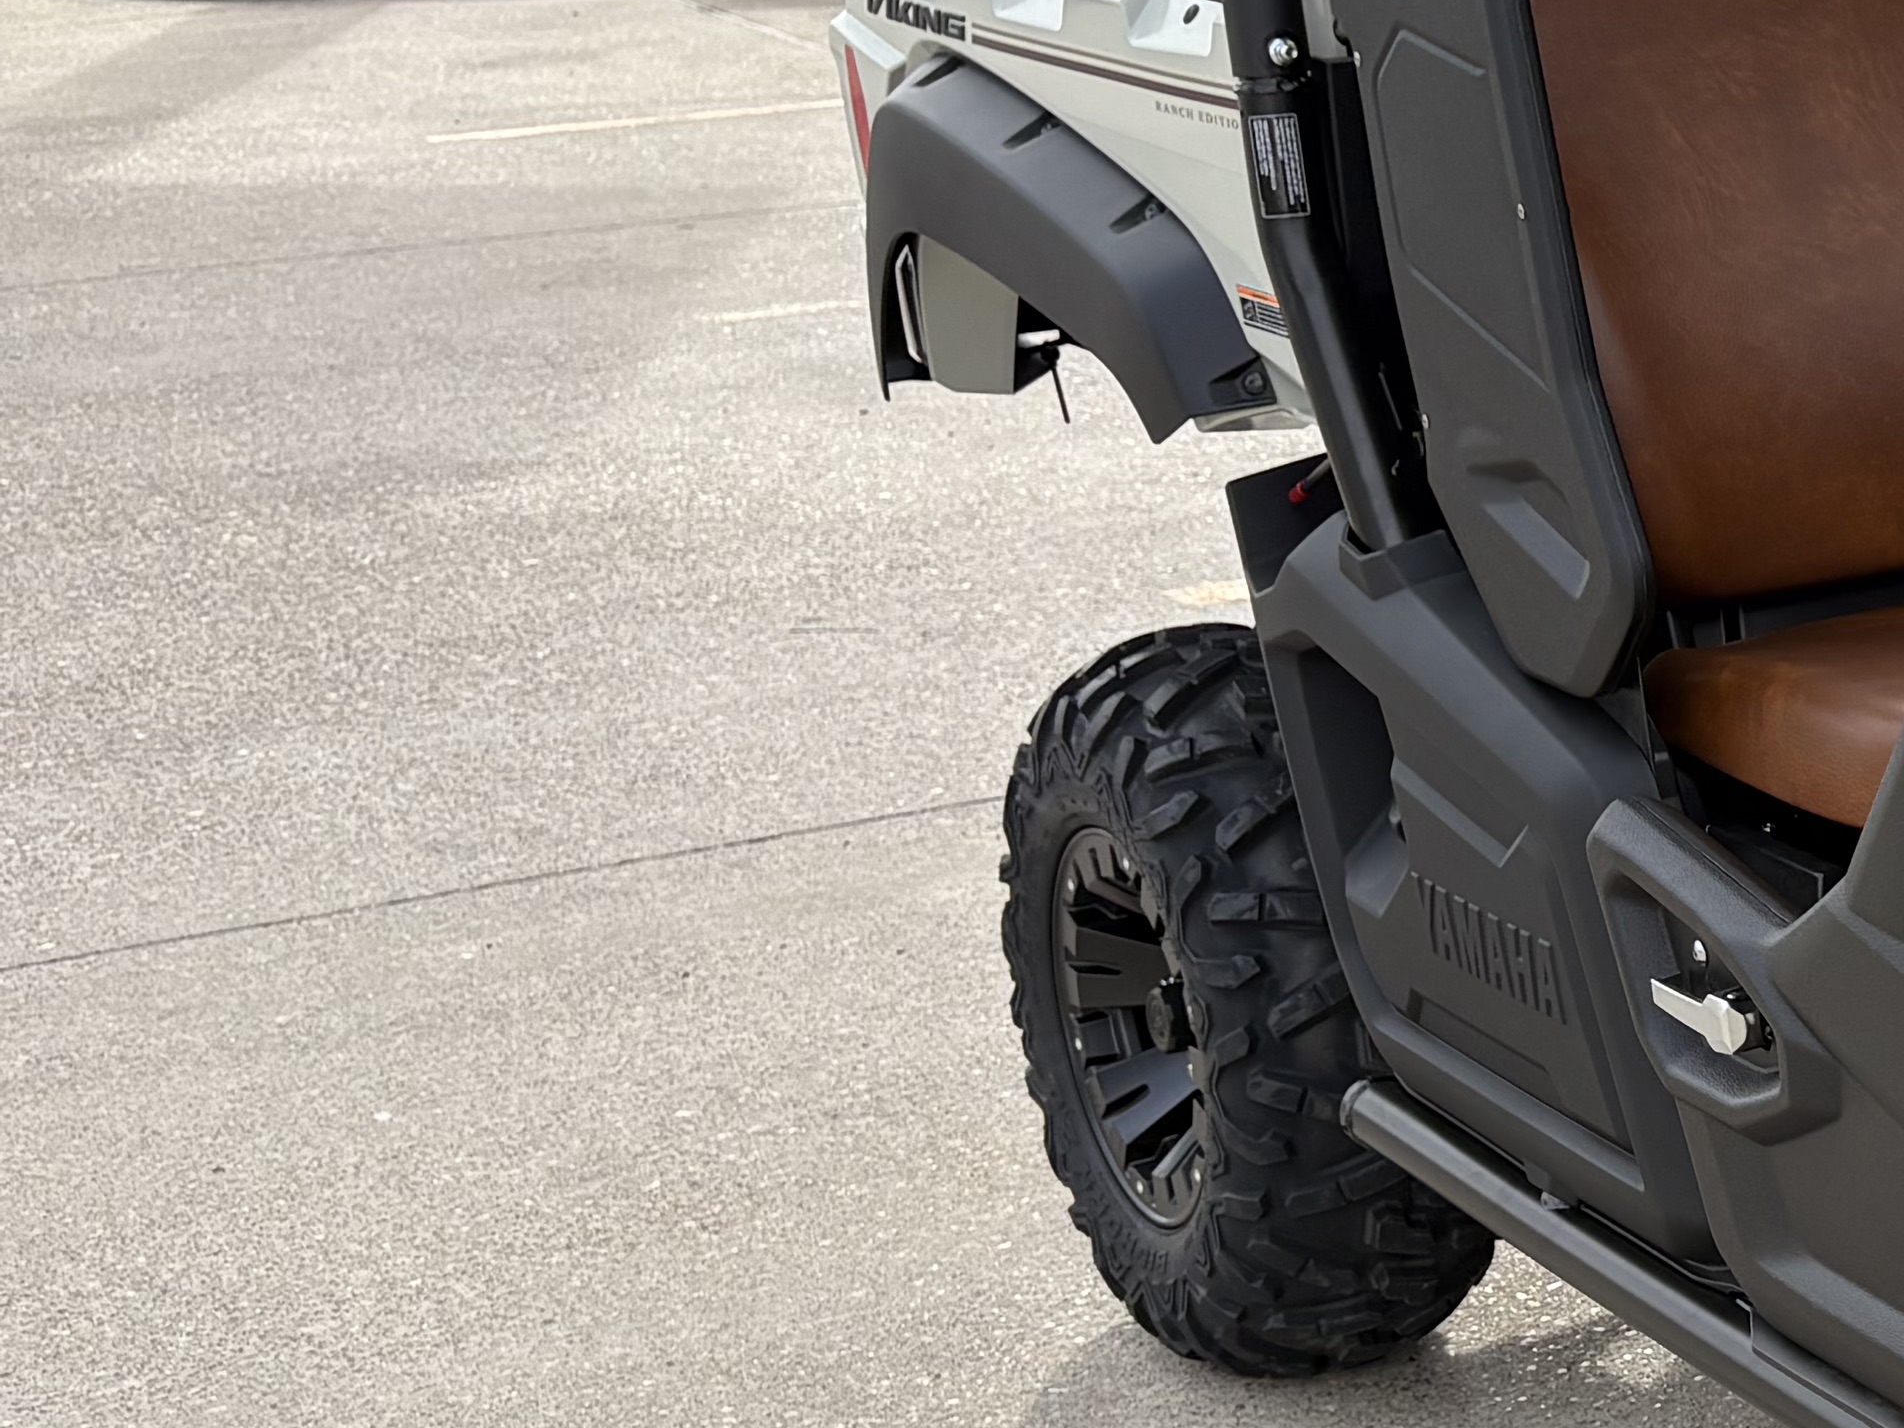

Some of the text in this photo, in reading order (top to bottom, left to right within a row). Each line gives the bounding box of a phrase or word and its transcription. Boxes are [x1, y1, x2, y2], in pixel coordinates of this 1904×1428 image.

[1155, 100, 1240, 131] RANCH EDITIO
[1410, 871, 1568, 1026] YAMAHA
